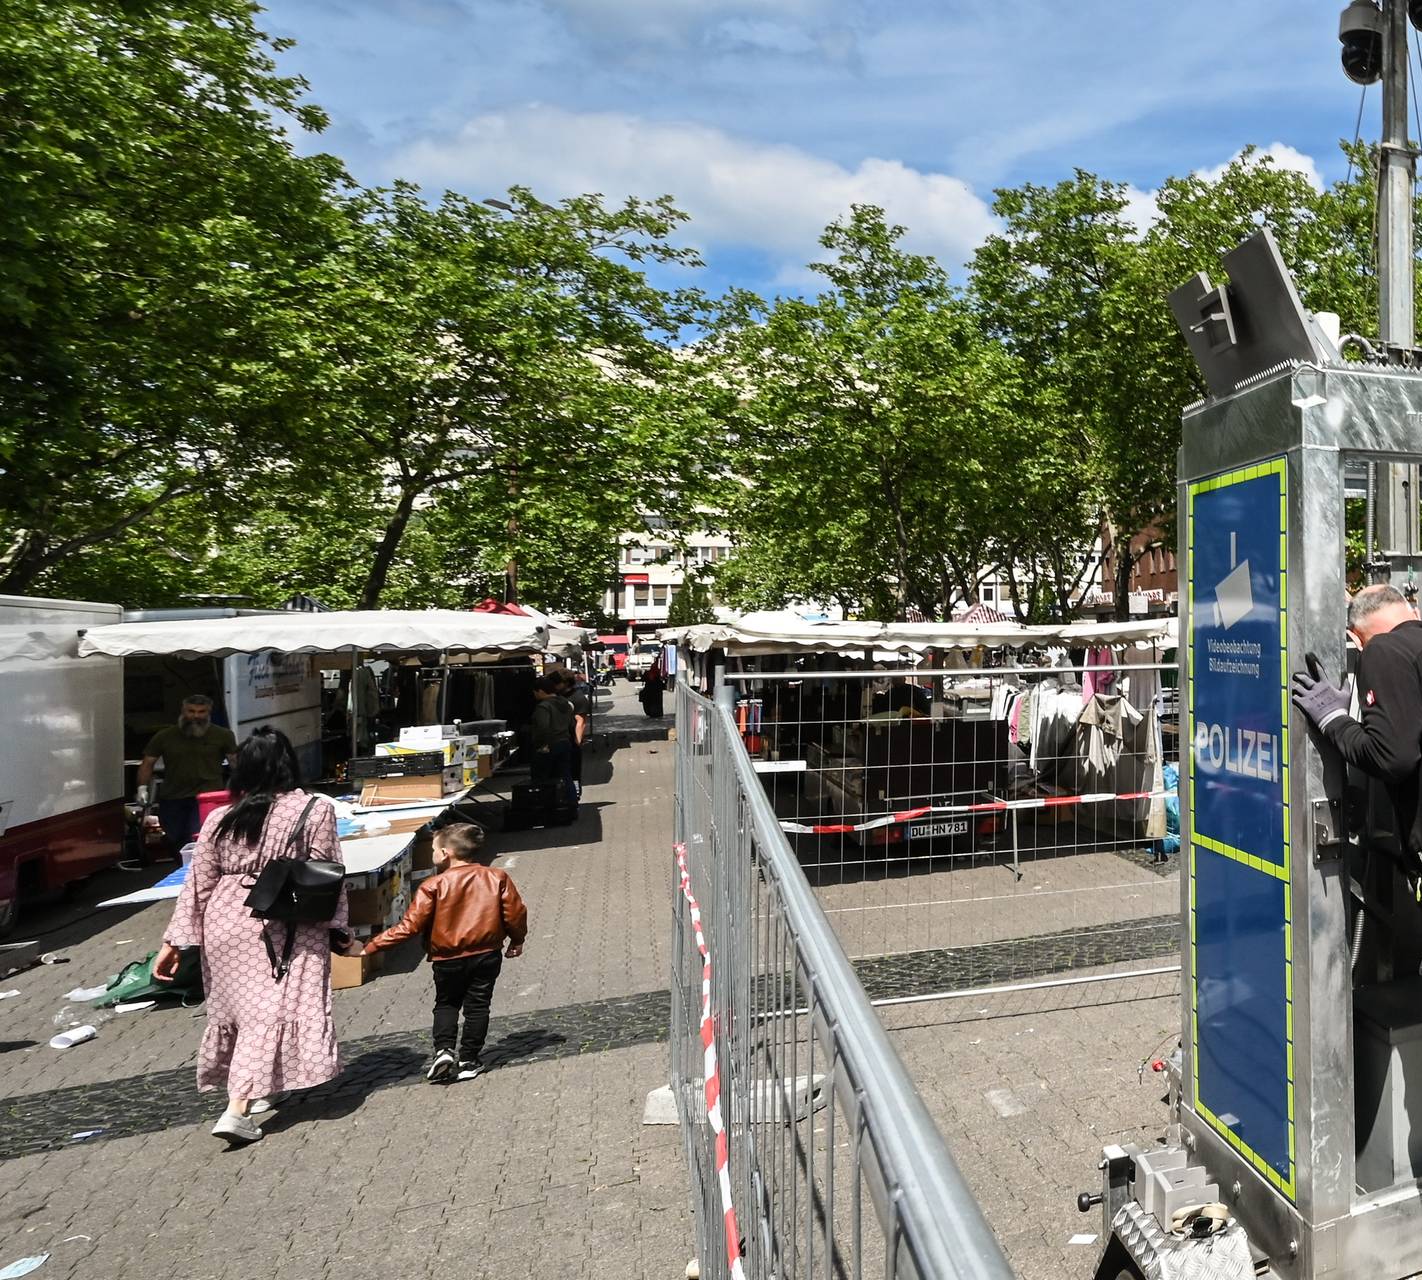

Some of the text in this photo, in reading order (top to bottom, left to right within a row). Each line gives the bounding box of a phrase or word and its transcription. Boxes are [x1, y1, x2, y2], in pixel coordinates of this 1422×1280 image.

[1207, 638, 1261, 658] Videobeobachtung
[1208, 657, 1260, 678] Bildaufzeichnung
[1195, 721, 1279, 784] POLIZEI
